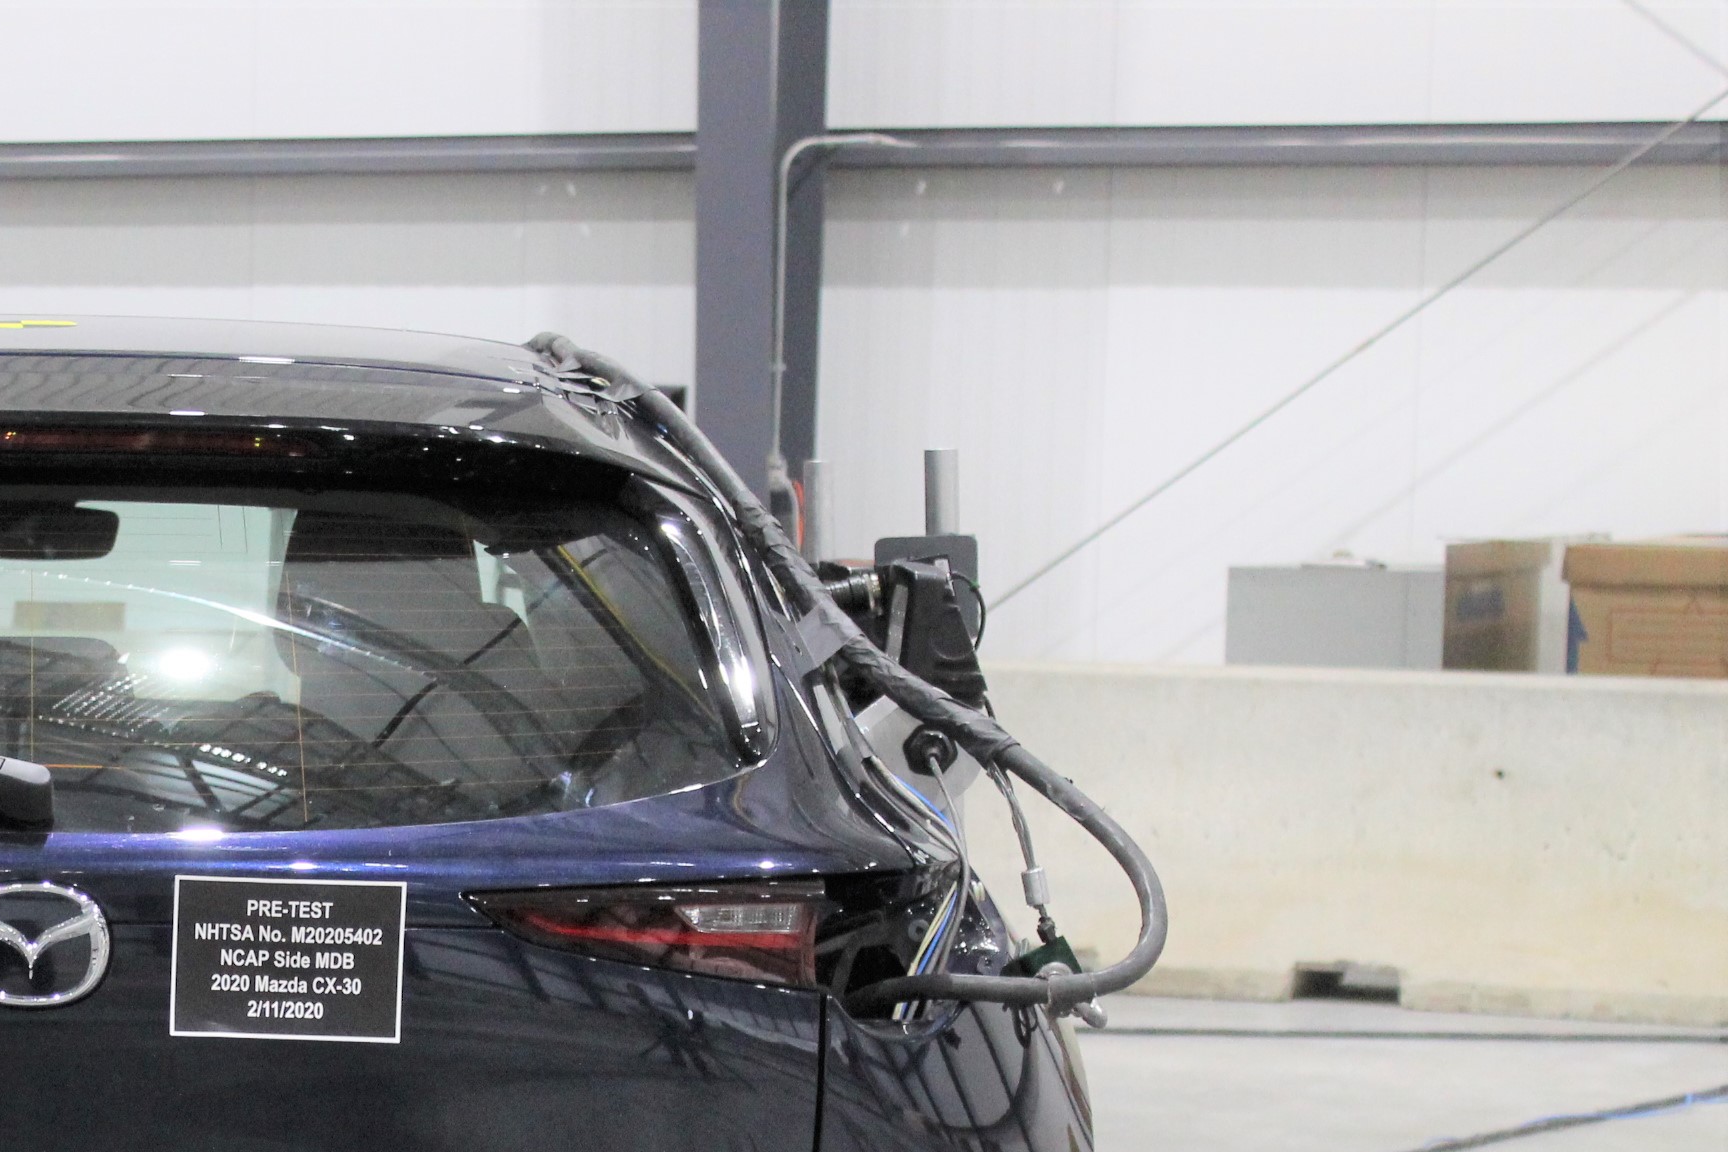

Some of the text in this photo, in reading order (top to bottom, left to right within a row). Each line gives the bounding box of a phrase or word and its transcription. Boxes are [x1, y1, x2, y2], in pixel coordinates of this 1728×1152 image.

[246, 900, 333, 919] PRE-TEST
[194, 923, 383, 945] NHTSA No. M20205402
[220, 949, 355, 969] NCAP Side MDB
[211, 974, 362, 995] 2020 Mazda CX-30
[247, 1000, 324, 1019] 2/11/2020
